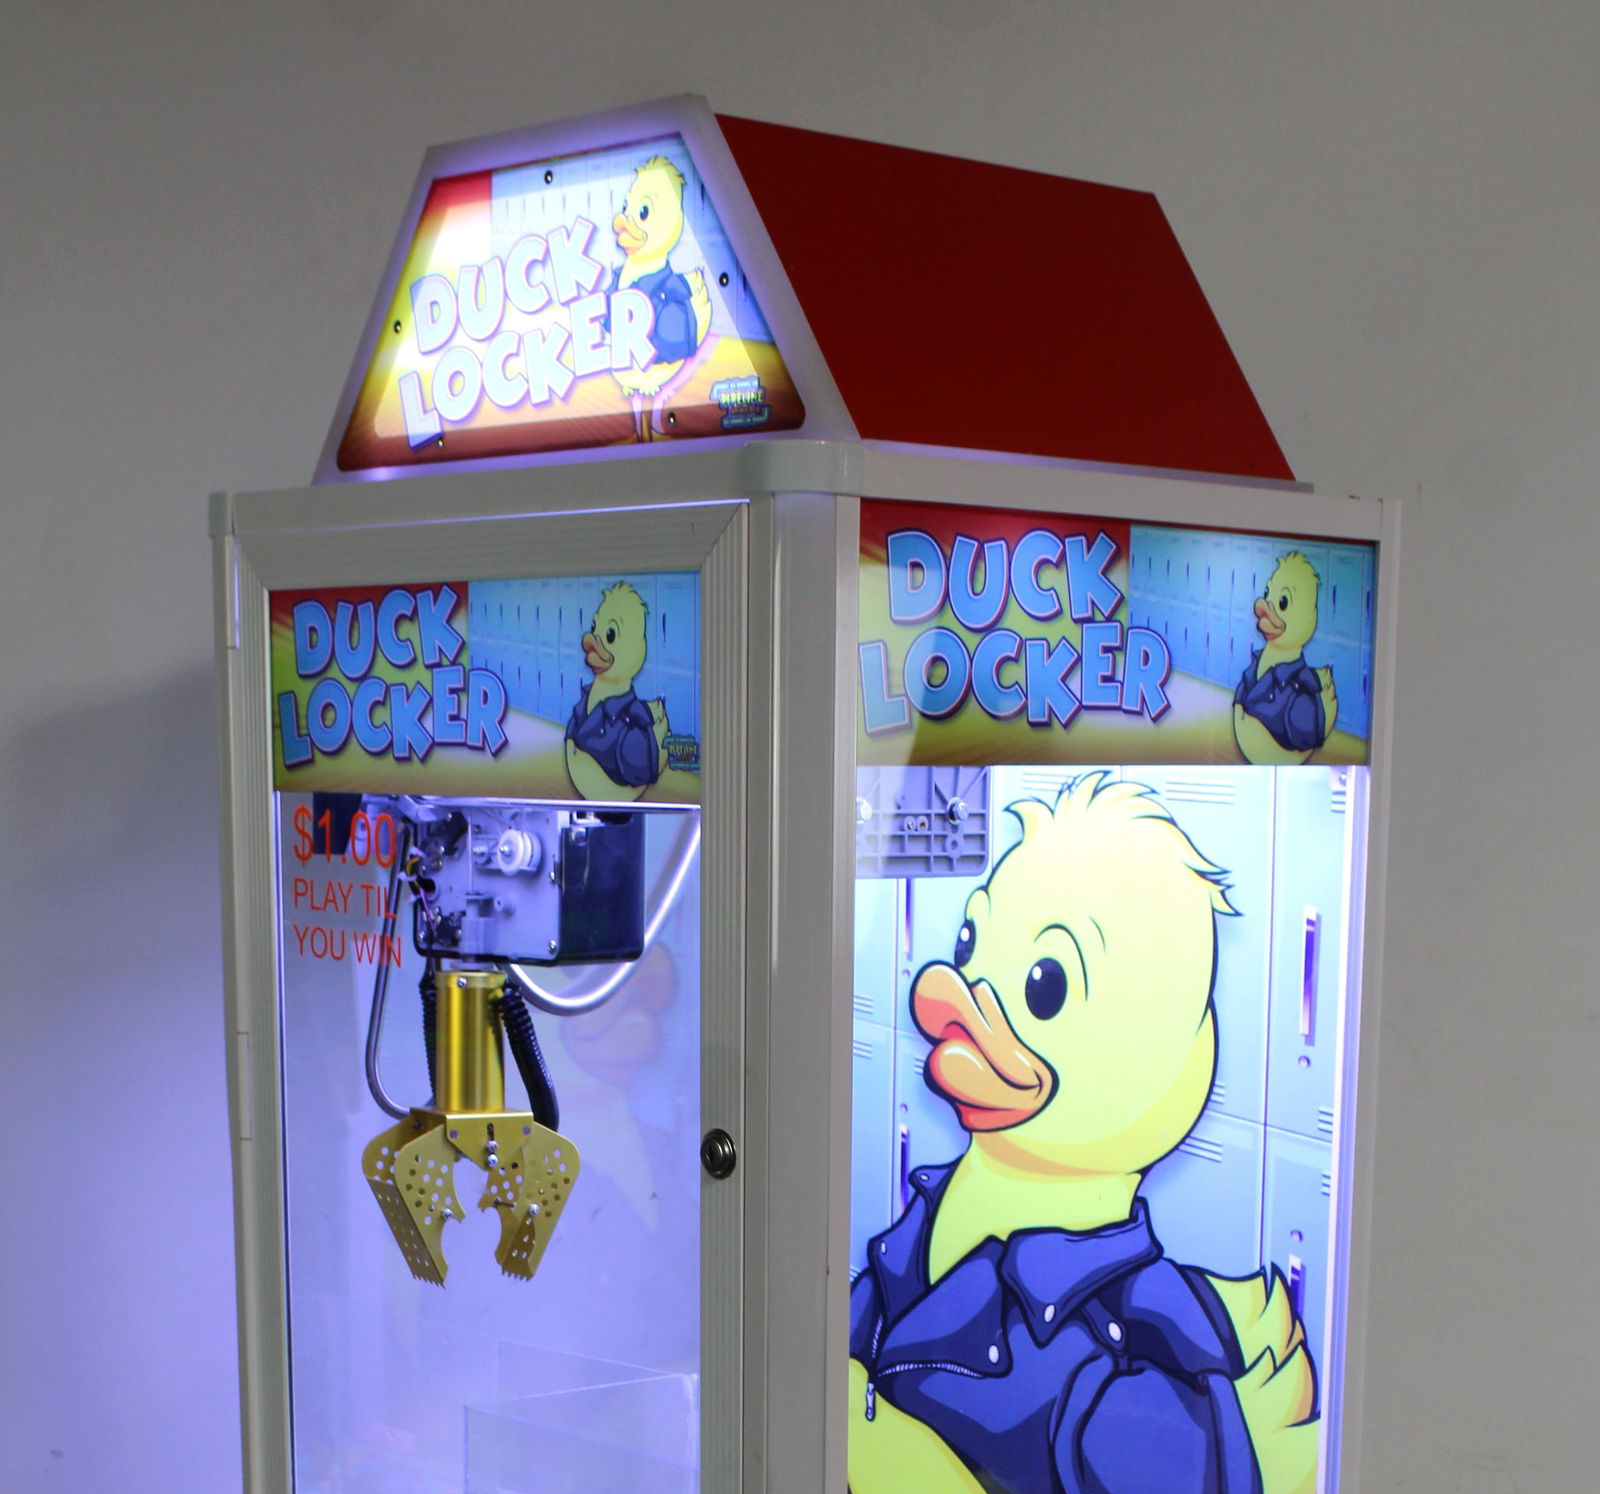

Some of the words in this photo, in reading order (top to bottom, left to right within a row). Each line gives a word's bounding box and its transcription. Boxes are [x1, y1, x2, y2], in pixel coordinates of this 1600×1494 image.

[410, 216, 602, 353] DUCK
[399, 289, 657, 450] LOCKER
[886, 528, 1124, 631] DUCK
[292, 584, 465, 679] DUCK
[858, 622, 1171, 737] LOCKER
[277, 665, 508, 768] LOCKER
[293, 805, 395, 868] $1.00
[293, 877, 353, 913] PLAY
[360, 884, 396, 919] TIL
[293, 924, 346, 961] YOU
[353, 931, 402, 968] WIN
